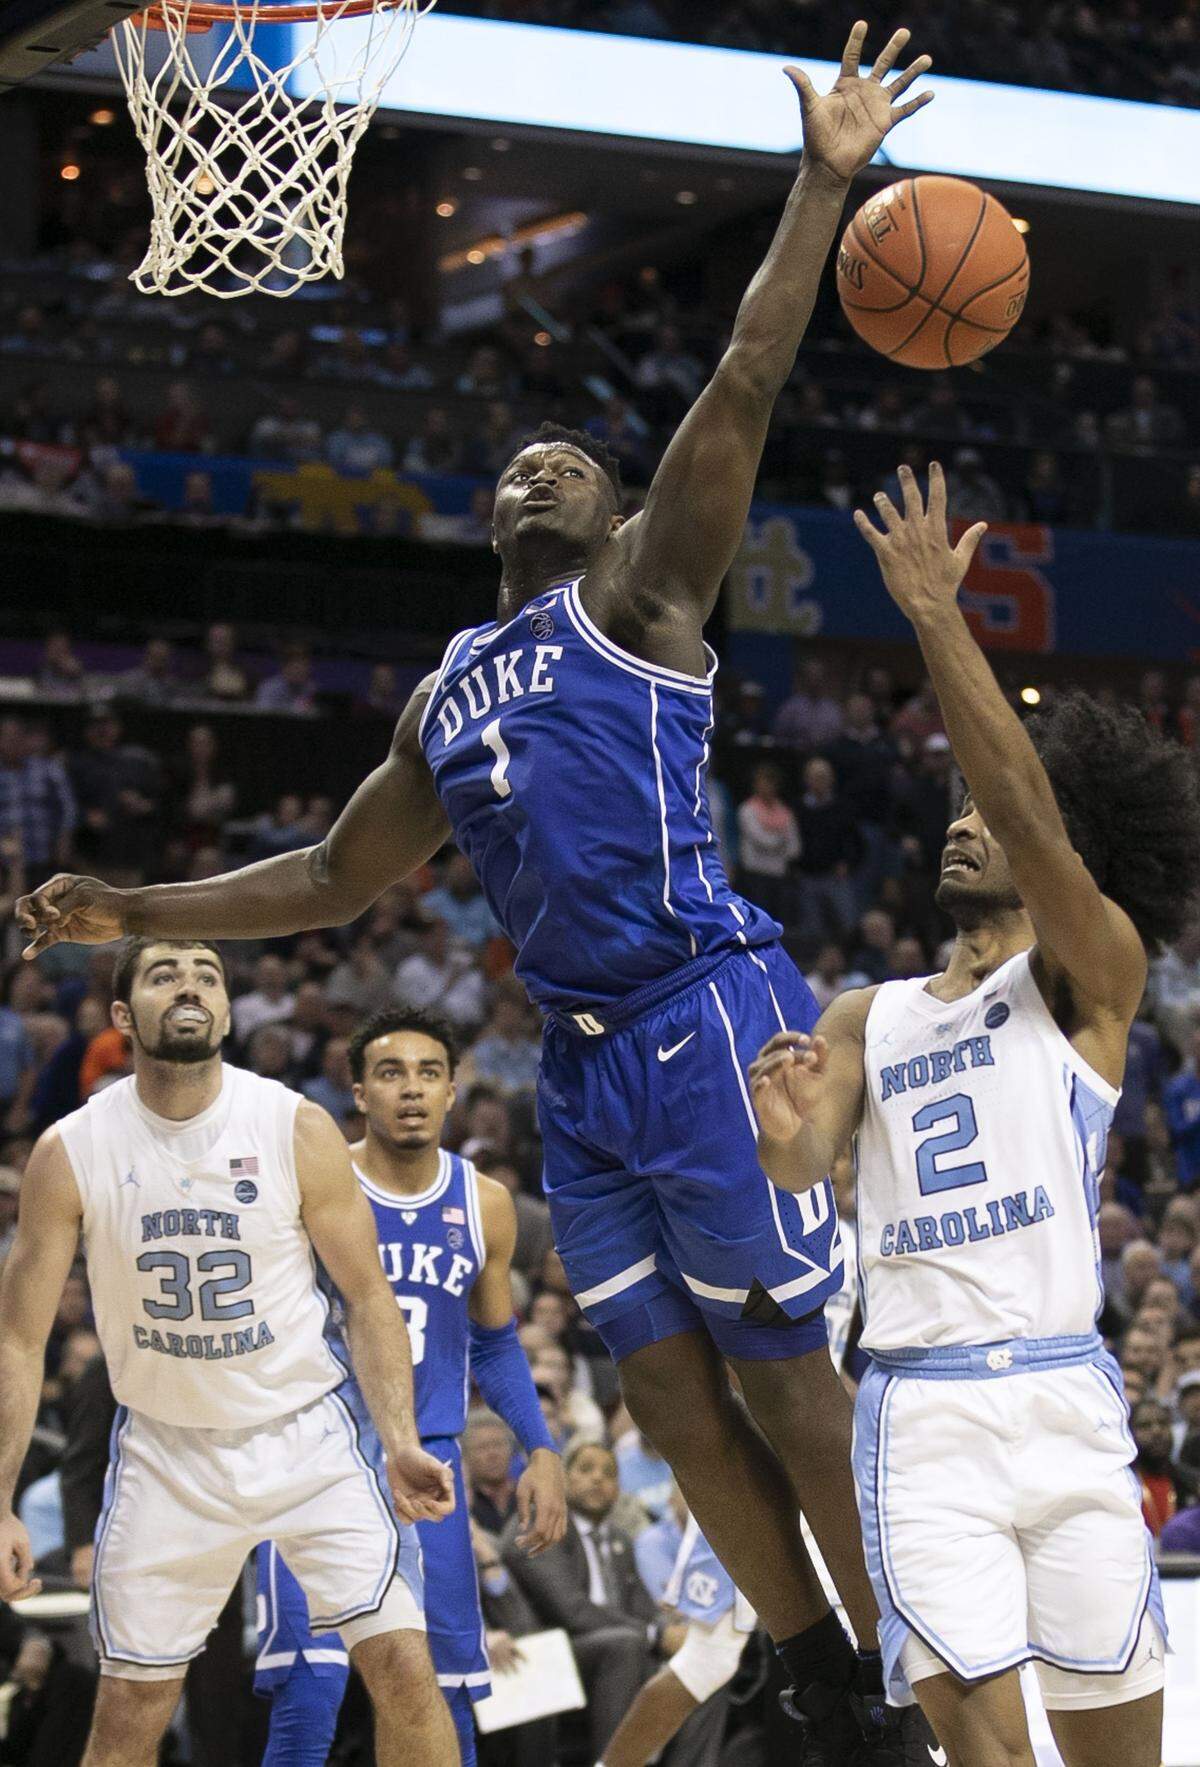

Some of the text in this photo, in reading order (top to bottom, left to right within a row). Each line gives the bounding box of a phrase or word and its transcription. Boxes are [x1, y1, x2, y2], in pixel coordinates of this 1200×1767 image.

[437, 645, 563, 747] DUKE
[481, 718, 512, 798] 1
[879, 1035, 995, 1102] NORTH
[911, 1092, 988, 1196] 2
[141, 1208, 241, 1243] NORTH
[879, 1185, 1055, 1257] CAROLINA
[136, 1249, 255, 1321] 32
[378, 1242, 474, 1297] UKE
[132, 1321, 275, 1360] CAROLINA
